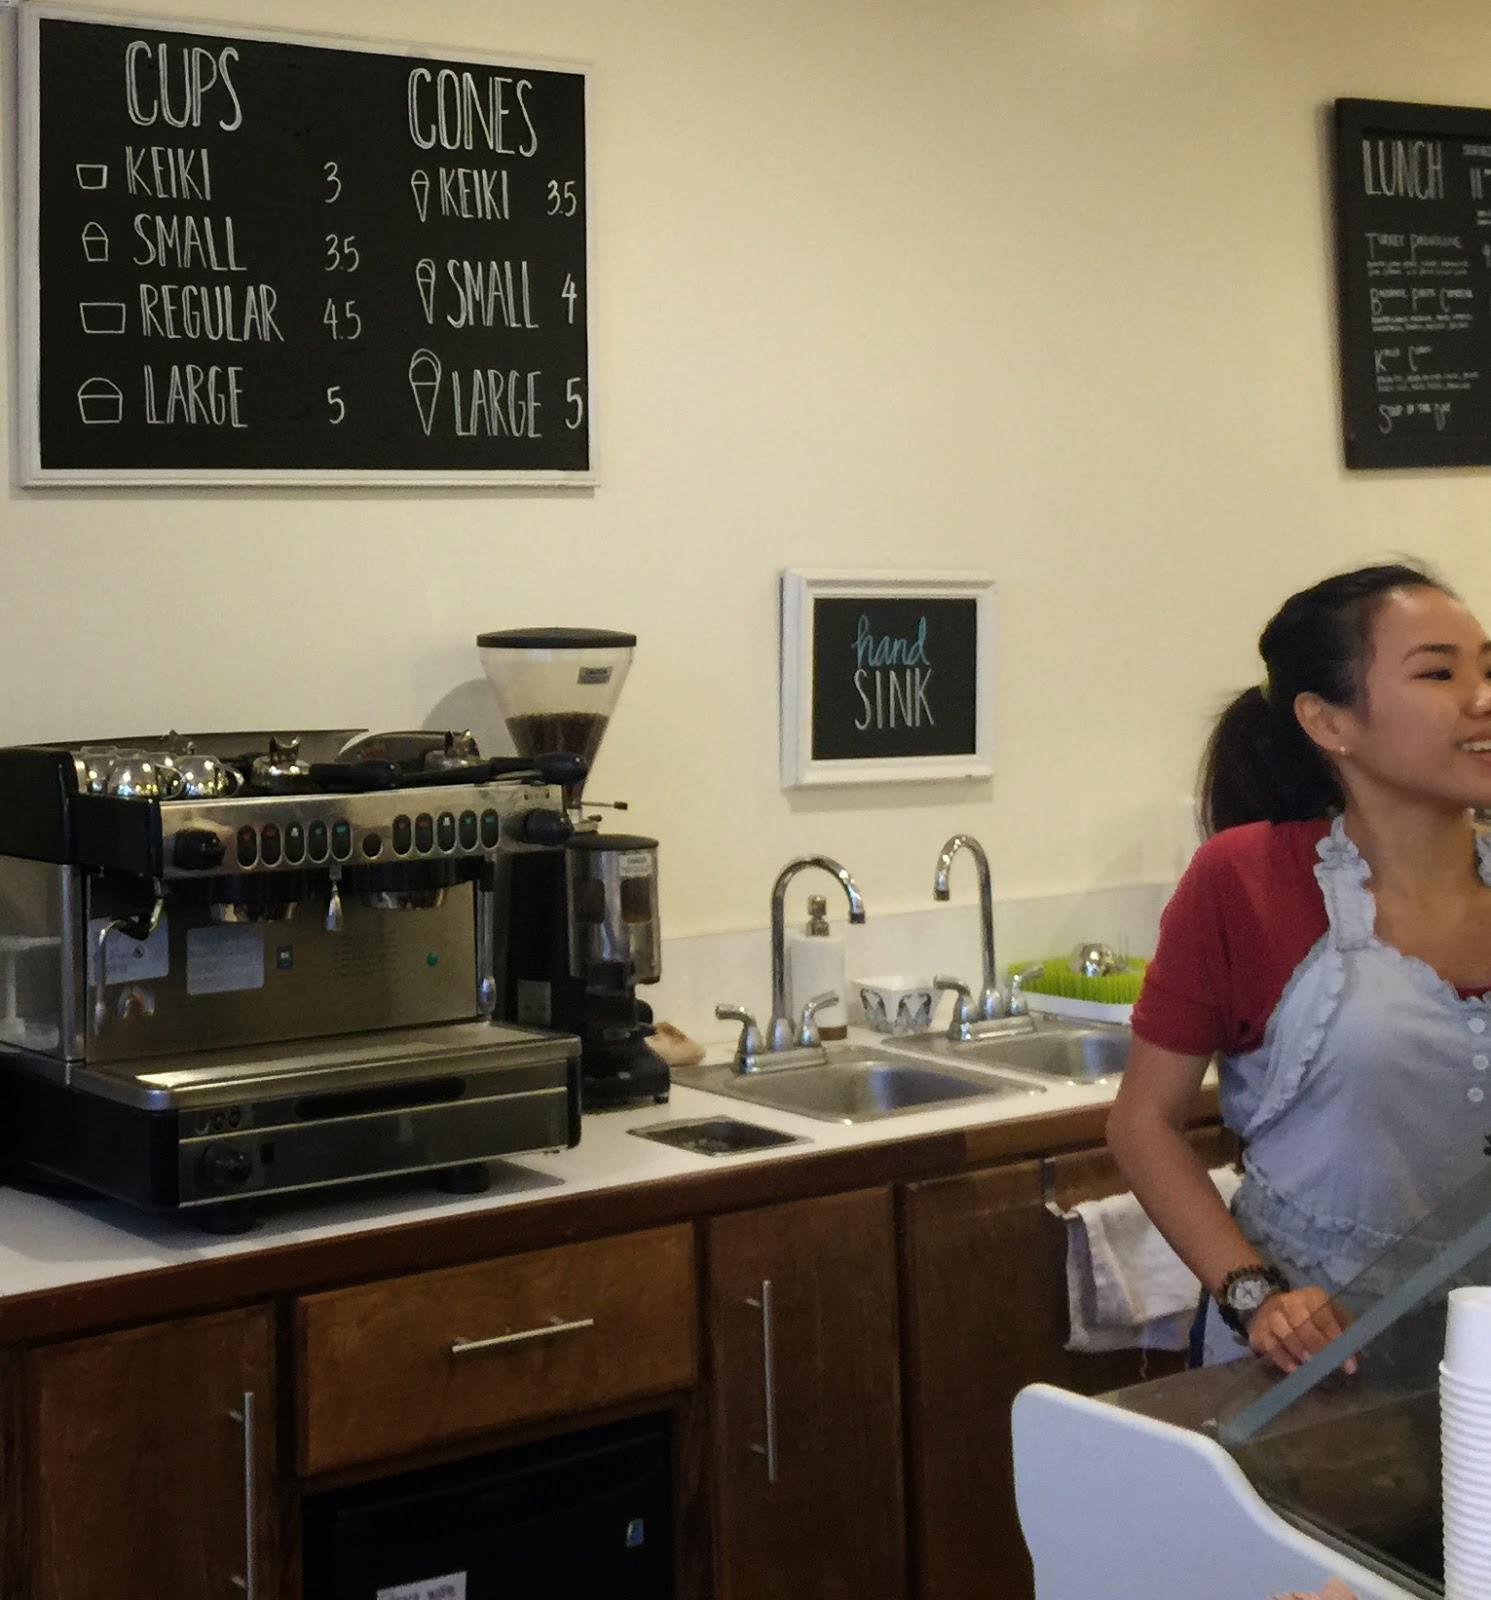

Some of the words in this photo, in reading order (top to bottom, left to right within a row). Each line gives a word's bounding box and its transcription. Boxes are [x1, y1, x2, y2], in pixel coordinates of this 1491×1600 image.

[125, 40, 242, 131] CUPS
[407, 67, 538, 157] CONES
[125, 146, 211, 200] KEIKI
[323, 161, 342, 203] 3
[439, 167, 510, 220] KEIKI
[1362, 139, 1444, 199] LUNCH
[132, 213, 248, 271] SMALL
[139, 284, 284, 342] REGULAR
[446, 259, 539, 329] SMALL
[561, 273, 578, 325] 4
[143, 364, 248, 428] LARGE
[326, 385, 346, 425] 5
[451, 369, 542, 438] LARGE
[565, 376, 584, 430] 5
[852, 613, 930, 668] hand
[853, 667, 935, 731] SINK
